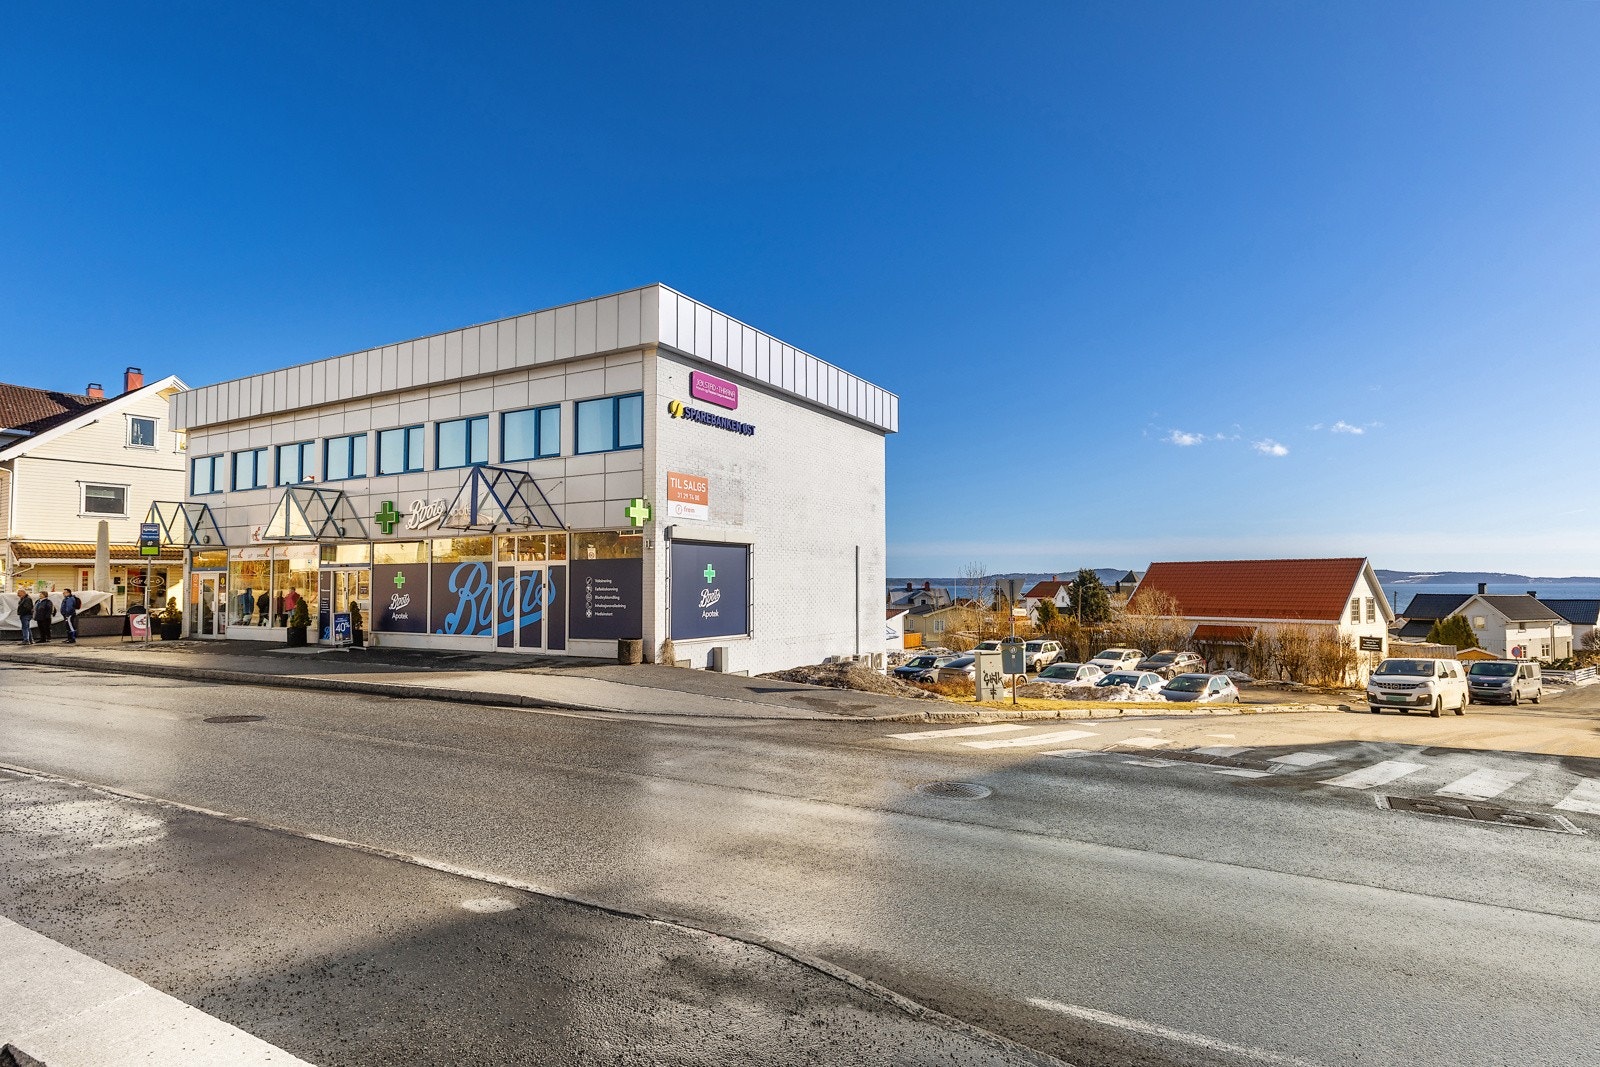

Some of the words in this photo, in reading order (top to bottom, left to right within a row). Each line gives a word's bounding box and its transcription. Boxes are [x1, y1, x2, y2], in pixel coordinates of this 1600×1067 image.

[683, 406, 742, 432] SPAREBANKEN
[670, 477, 682, 489] TIL
[683, 480, 706, 493] SALGS
[405, 498, 447, 530] Boots
[388, 593, 411, 610] Boots
[436, 561, 556, 636] Boots
[698, 588, 721, 608] Boots
[391, 612, 408, 621] Apotek
[701, 609, 720, 620] Apotek
